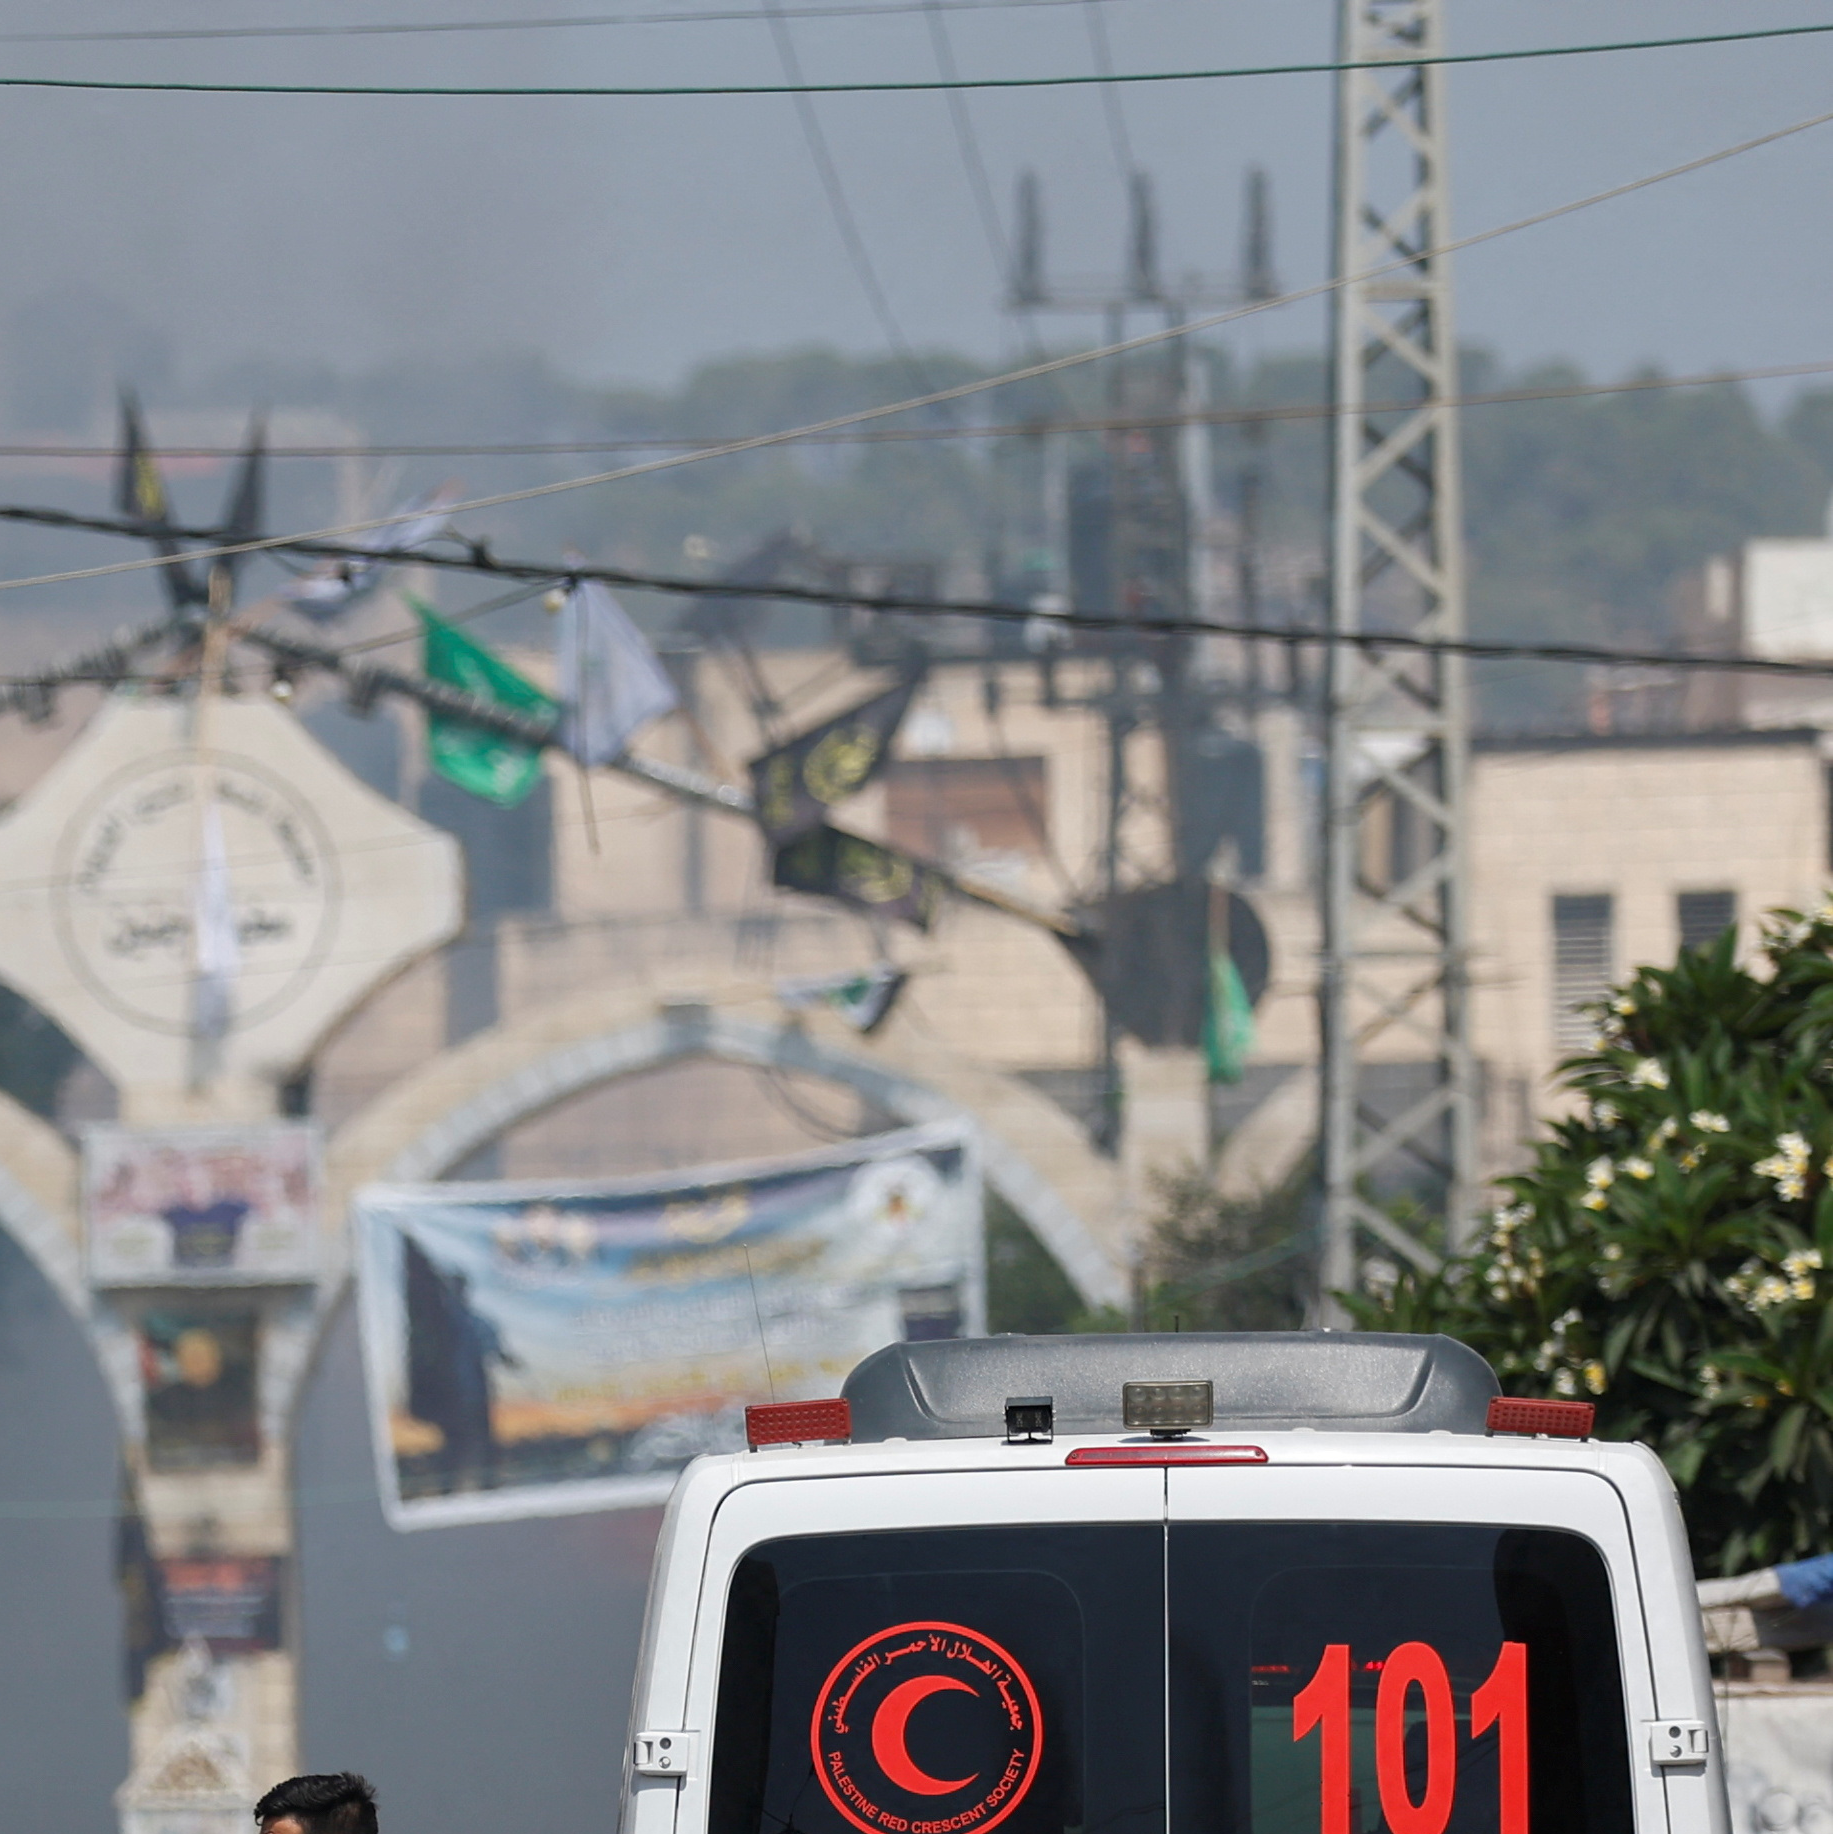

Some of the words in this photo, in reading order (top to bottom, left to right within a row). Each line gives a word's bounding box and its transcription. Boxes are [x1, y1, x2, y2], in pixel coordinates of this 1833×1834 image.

[945, 1639, 1002, 1681] الهلال
[996, 1673, 1025, 1732] جمعية
[827, 1750, 879, 1820] PALESTINE
[878, 1810, 908, 1833] RED
[911, 1803, 988, 1834] CRESCENT
[985, 1747, 1026, 1808] SOCIETY
